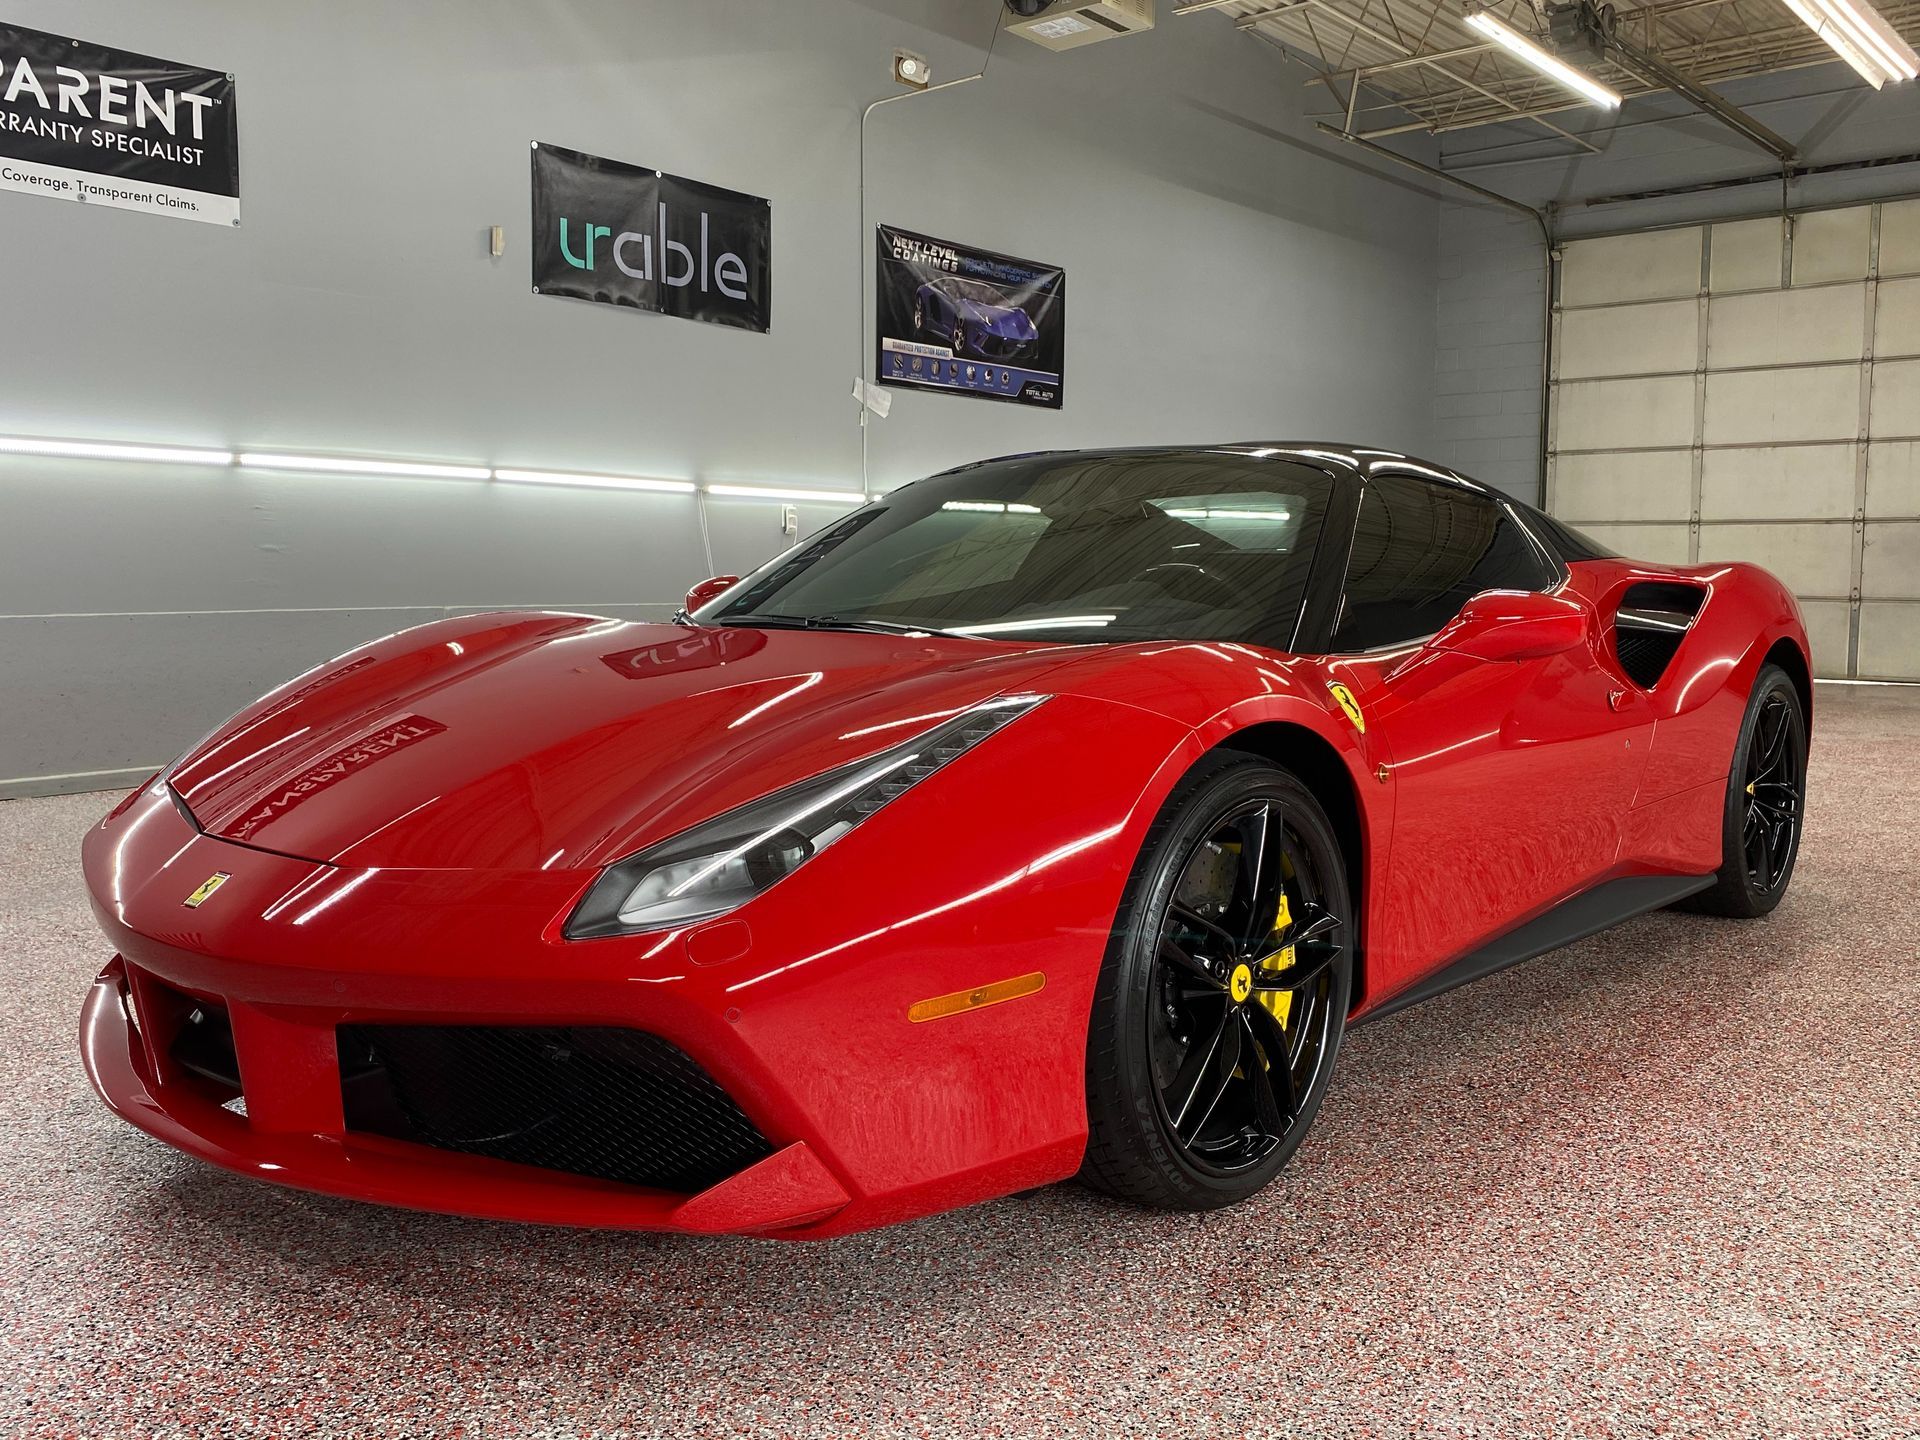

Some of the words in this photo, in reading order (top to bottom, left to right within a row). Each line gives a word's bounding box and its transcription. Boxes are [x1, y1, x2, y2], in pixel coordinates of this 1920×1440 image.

[91, 129, 204, 167] SPECIALIST
[2, 167, 73, 191] Coverage.
[76, 179, 153, 203] Transparent
[156, 194, 199, 212] Claims.
[560, 202, 747, 300] urable
[893, 235, 922, 252] NEXT
[923, 243, 958, 261] LEVEL
[893, 247, 959, 272] COATINGS
